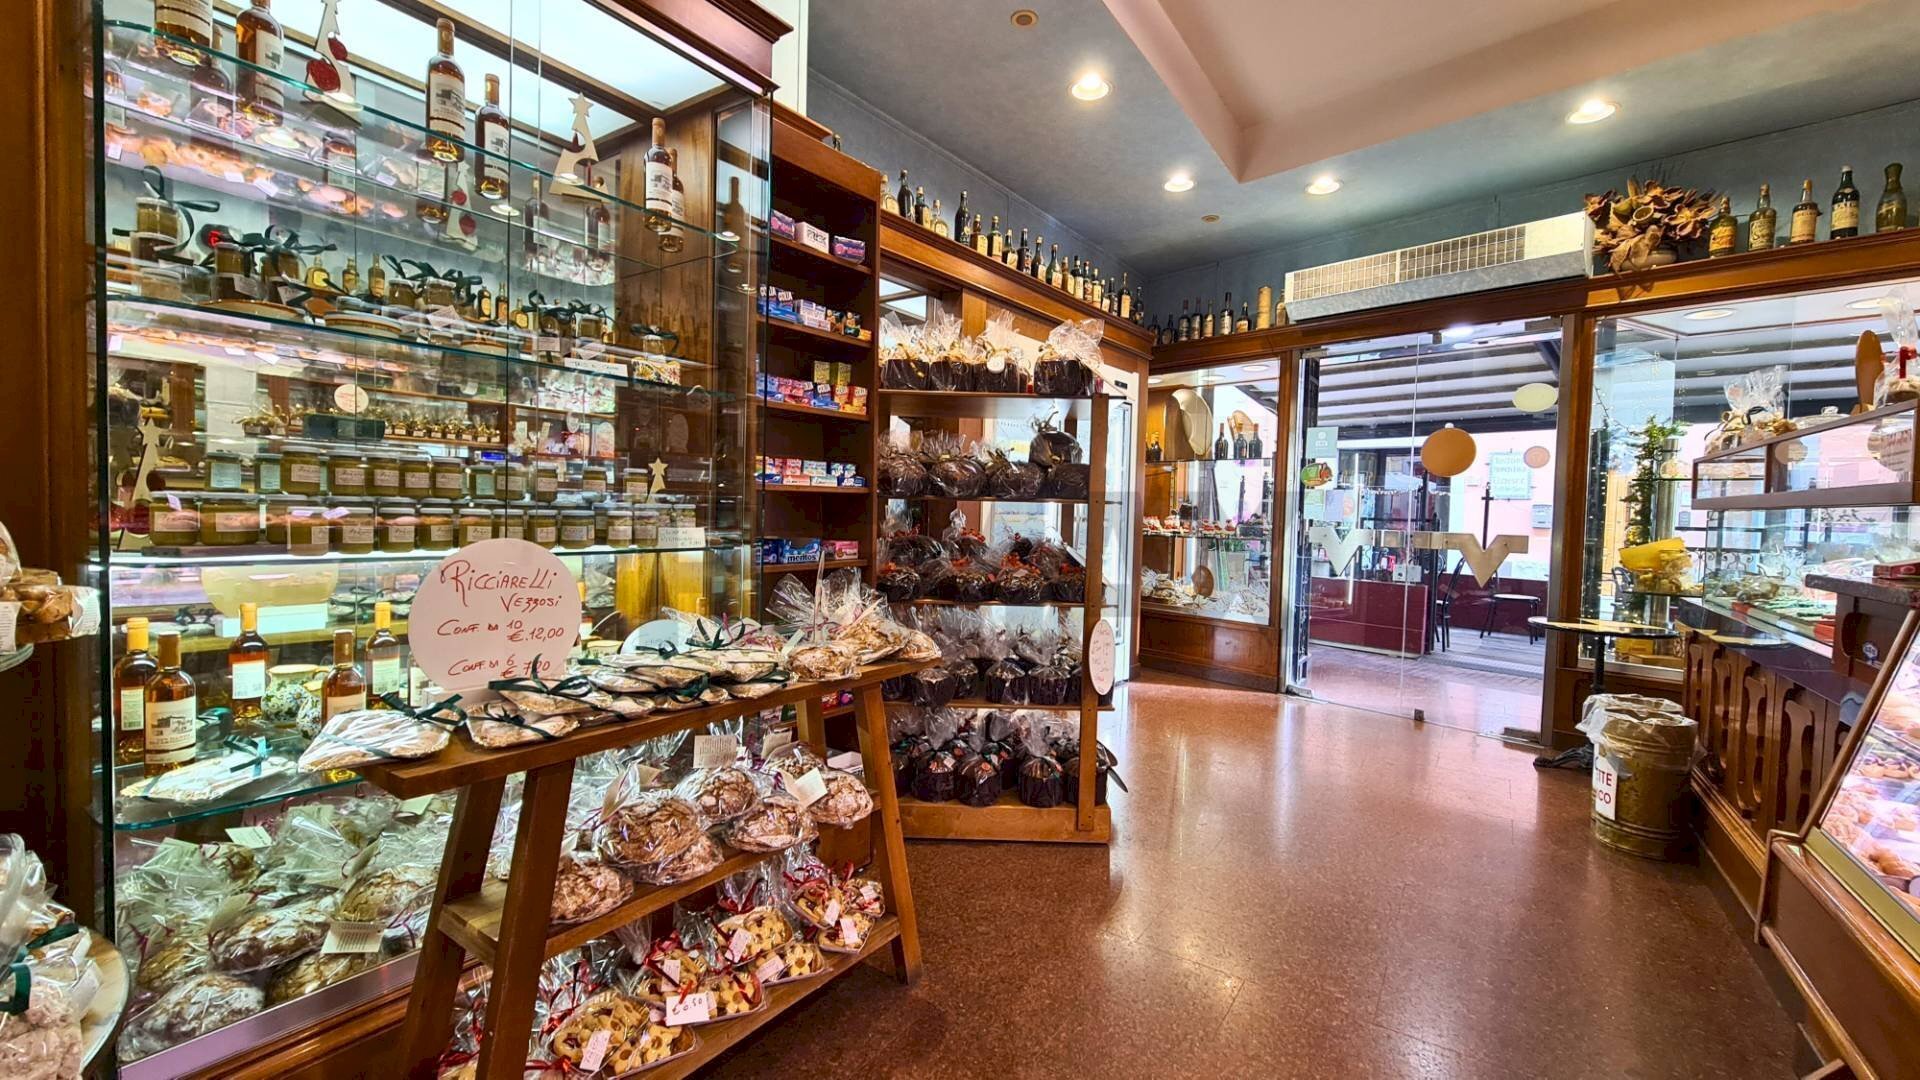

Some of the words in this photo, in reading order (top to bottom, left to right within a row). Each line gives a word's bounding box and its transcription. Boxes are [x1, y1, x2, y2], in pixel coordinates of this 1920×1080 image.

[787, 553, 818, 563] mentos
[506, 619, 523, 630] 10
[506, 653, 515, 666] 6
